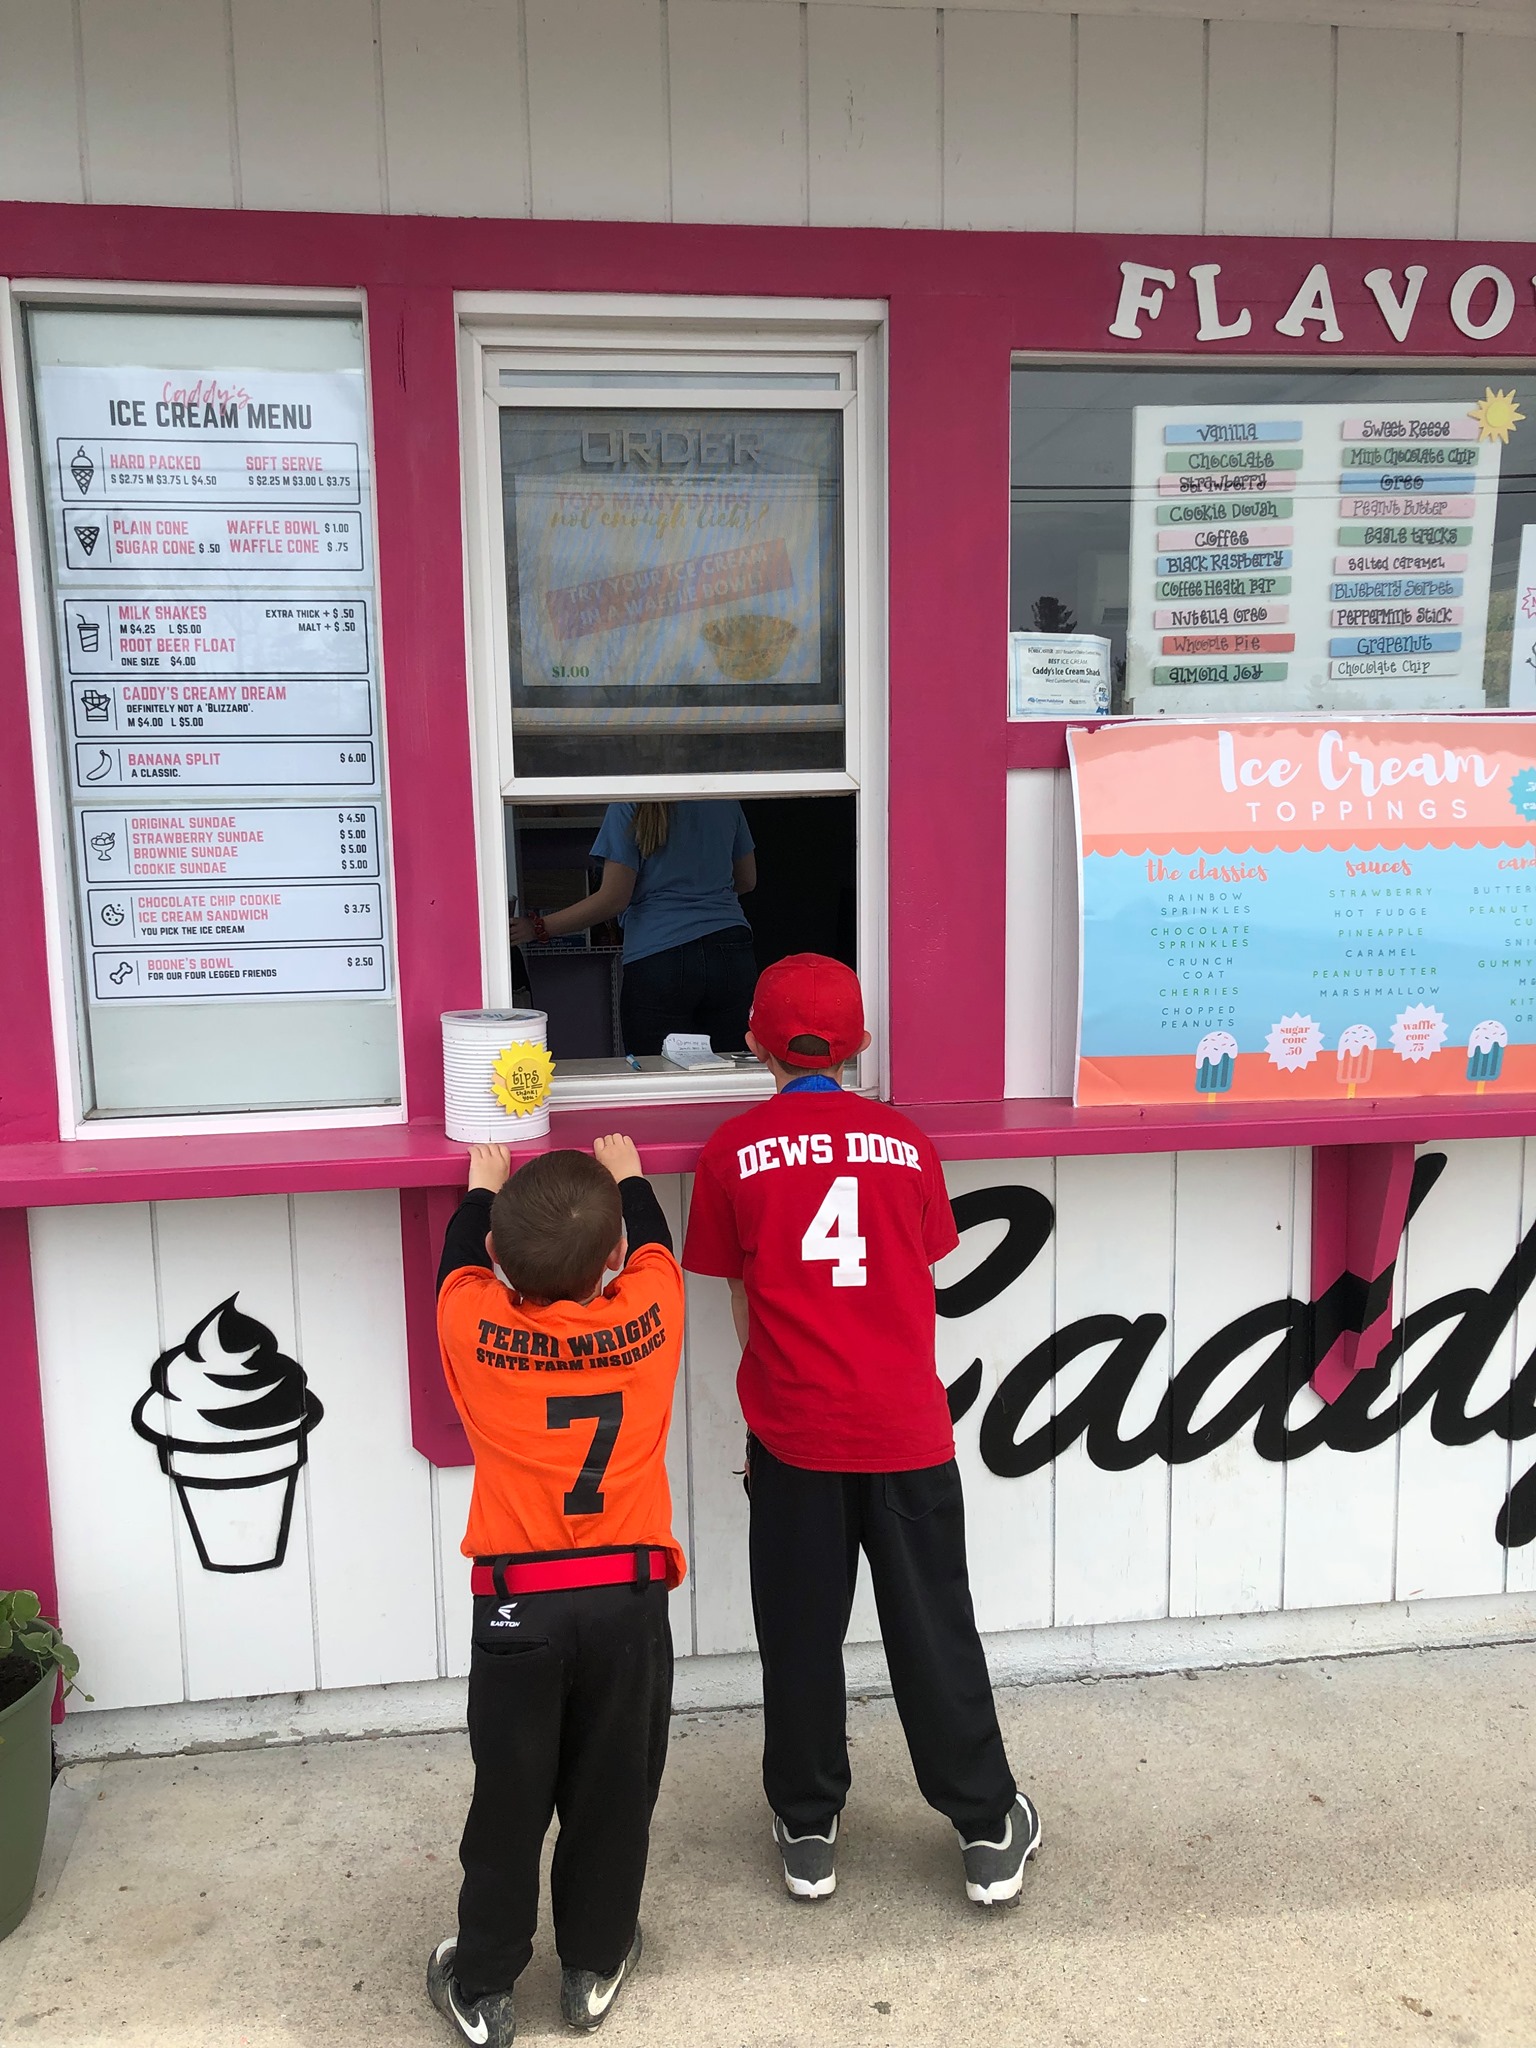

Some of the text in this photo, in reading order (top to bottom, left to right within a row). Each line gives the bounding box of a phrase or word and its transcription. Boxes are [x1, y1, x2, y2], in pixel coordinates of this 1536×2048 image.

[1108, 261, 1536, 342] FLAVO
[109, 400, 312, 429] ICE CREAM MENU
[1362, 421, 1450, 438] Sweet Reese
[581, 429, 764, 466] ORDER
[110, 454, 201, 470] HARD PACKED
[246, 456, 322, 471] SOFT SERVE
[1189, 452, 1274, 470] Chocolate
[1351, 448, 1382, 465] Mint
[1384, 450, 1444, 465] Chocolate
[1180, 473, 1267, 493] Strawberry
[1170, 501, 1278, 521] Cookie Dough
[1353, 500, 1448, 516] Peanut Butter
[113, 520, 188, 535] PLAIN CONE
[227, 520, 320, 535] WAFFLE BOWL
[1195, 530, 1249, 547] Coffee
[116, 540, 195, 555] SUGAR CONE
[230, 539, 319, 553] WAFFLE CONE
[1166, 551, 1283, 573] Black Raspberry
[1162, 578, 1276, 597] Coffee Heath Bar
[1335, 580, 1453, 599] Blueberry Sorbet
[119, 606, 207, 620] MILK SHAKES
[1171, 608, 1229, 625] Nutella
[1337, 608, 1452, 625] Peppermint Stick
[120, 638, 235, 652] ROOT BEER FLOAT
[1235, 636, 1260, 650] Pie
[1357, 636, 1432, 654] Grapenut
[121, 656, 196, 666] ONE SIZE $4.00
[1338, 660, 1430, 676] Chocolate Chip
[552, 665, 589, 679] $1.00
[1032, 667, 1055, 675] Caddy's
[123, 686, 286, 700] CADDY'S CREAMY DREAM
[127, 704, 175, 713] DEFINITELY
[177, 704, 195, 713] NOT
[197, 704, 203, 712] A
[128, 753, 220, 766] BANANA SPLIT
[1218, 729, 1499, 797] Ice Cream
[131, 768, 180, 778] A CLASSIC.
[1246, 799, 1467, 822] TOPPINGS
[131, 816, 236, 830] ORIGINAL SUNDAE
[133, 831, 264, 844] STRAWBERRY SUNDAE
[134, 846, 238, 859] BROWNIE SUNDAE
[134, 862, 227, 875] COOKIE SUNDAE
[1145, 857, 1269, 883] the classics
[1345, 859, 1412, 877] sauces
[1168, 893, 1242, 902] RAINBOW
[1329, 888, 1432, 898] STRAWBERRY
[138, 894, 281, 908] CHOCOLATE CHIP COOKIE
[139, 910, 268, 923] ICE CREAM SANDWICH
[1161, 906, 1251, 916] SPRINKLES
[1335, 908, 1426, 918] HOT FUDGE
[141, 926, 245, 936] YOU PICK THE ICE CREAM
[1151, 926, 1249, 936] CHOCOLATE
[1339, 928, 1423, 937] PINEAPPLE
[1159, 939, 1249, 949] SPRINKLES
[1346, 949, 1416, 958] CARAMEL
[147, 958, 233, 971] BOONE'S BOWL
[1168, 957, 1233, 967] CRUNCH
[148, 969, 276, 981] FOR OUR FOUR LEGGED FRIENDS
[1183, 971, 1224, 979] COAT
[1313, 968, 1437, 978] PEANUTBUTTER
[1160, 987, 1238, 997] CHERRIES
[1320, 987, 1440, 997] MARSHMALLOW
[1162, 1006, 1235, 1016] CHOPPED
[1162, 1019, 1235, 1028] PEANUTS
[1403, 1021, 1436, 1031] waffle
[1280, 1027, 1310, 1036] sugar
[1406, 1033, 1430, 1041] cone
[1282, 1035, 1307, 1044] cone
[1285, 1047, 1302, 1055] .50
[512, 1067, 539, 1088] tips
[737, 1132, 922, 1179] DEWS DOOR
[801, 1176, 867, 1287] 4
[478, 1302, 663, 1358] TERRI WRIGHT
[476, 1328, 666, 1371] STATE FARM INSURANCE
[546, 1391, 623, 1515] 7
